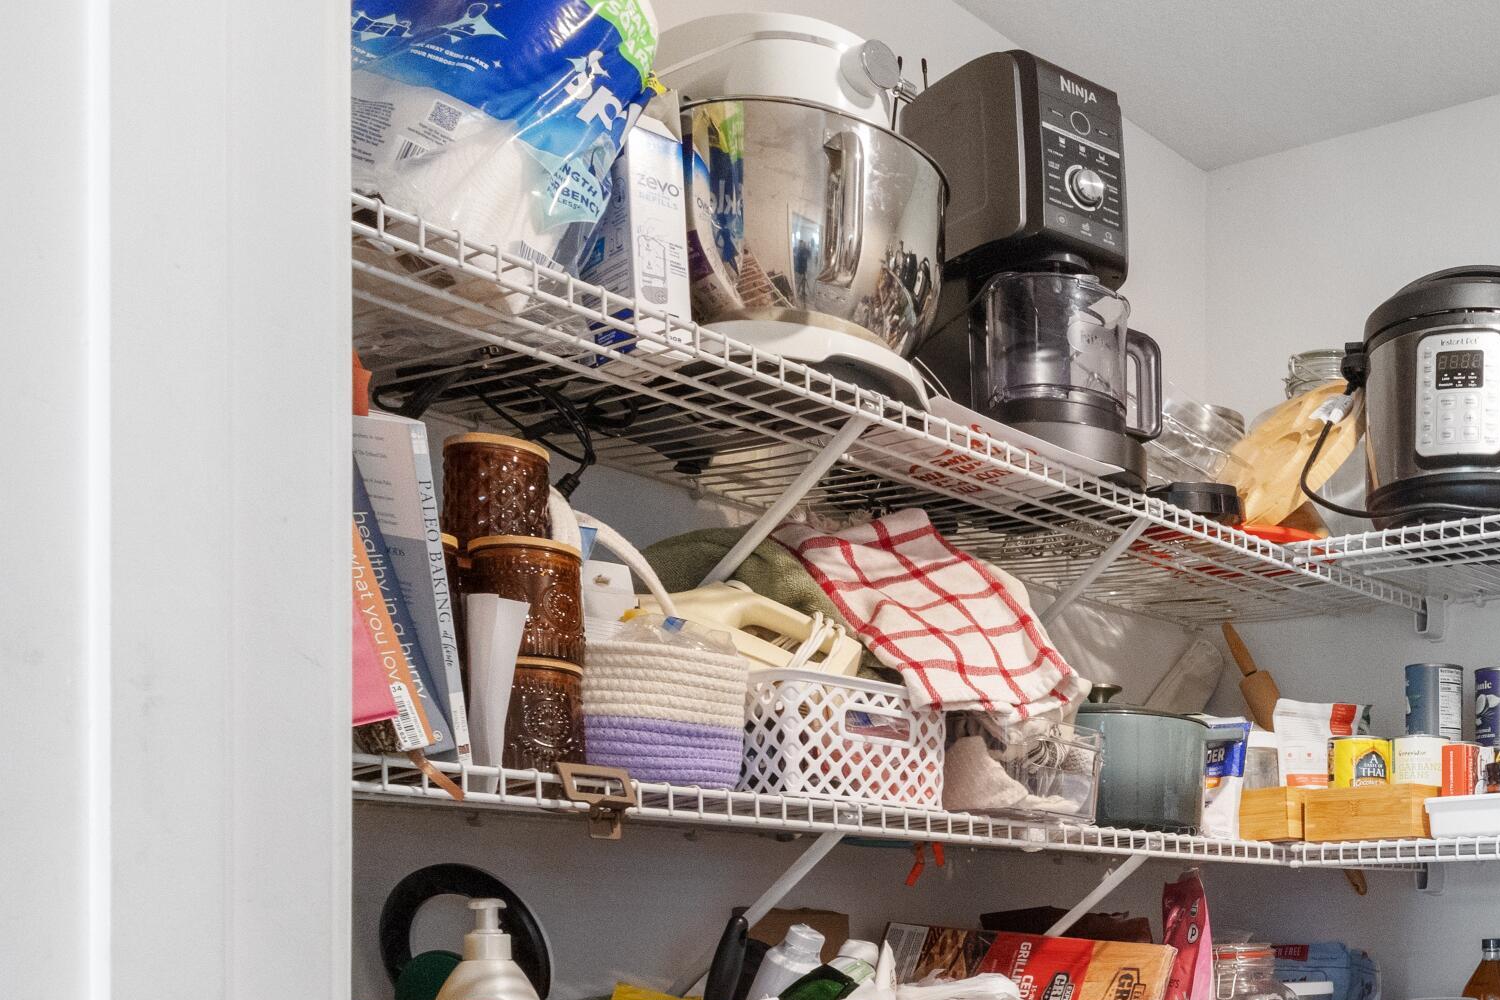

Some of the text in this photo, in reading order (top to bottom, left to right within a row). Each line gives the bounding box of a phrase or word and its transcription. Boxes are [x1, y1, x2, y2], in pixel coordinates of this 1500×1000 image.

[1059, 74, 1098, 104] NINJA
[418, 480, 441, 542] PALEO
[353, 511, 390, 591] healthy
[384, 597, 398, 616] in
[400, 643, 427, 699] hurry
[429, 551, 451, 623] BAKING
[362, 604, 388, 645] you
[380, 650, 402, 683] lov
[1370, 754, 1378, 764] A
